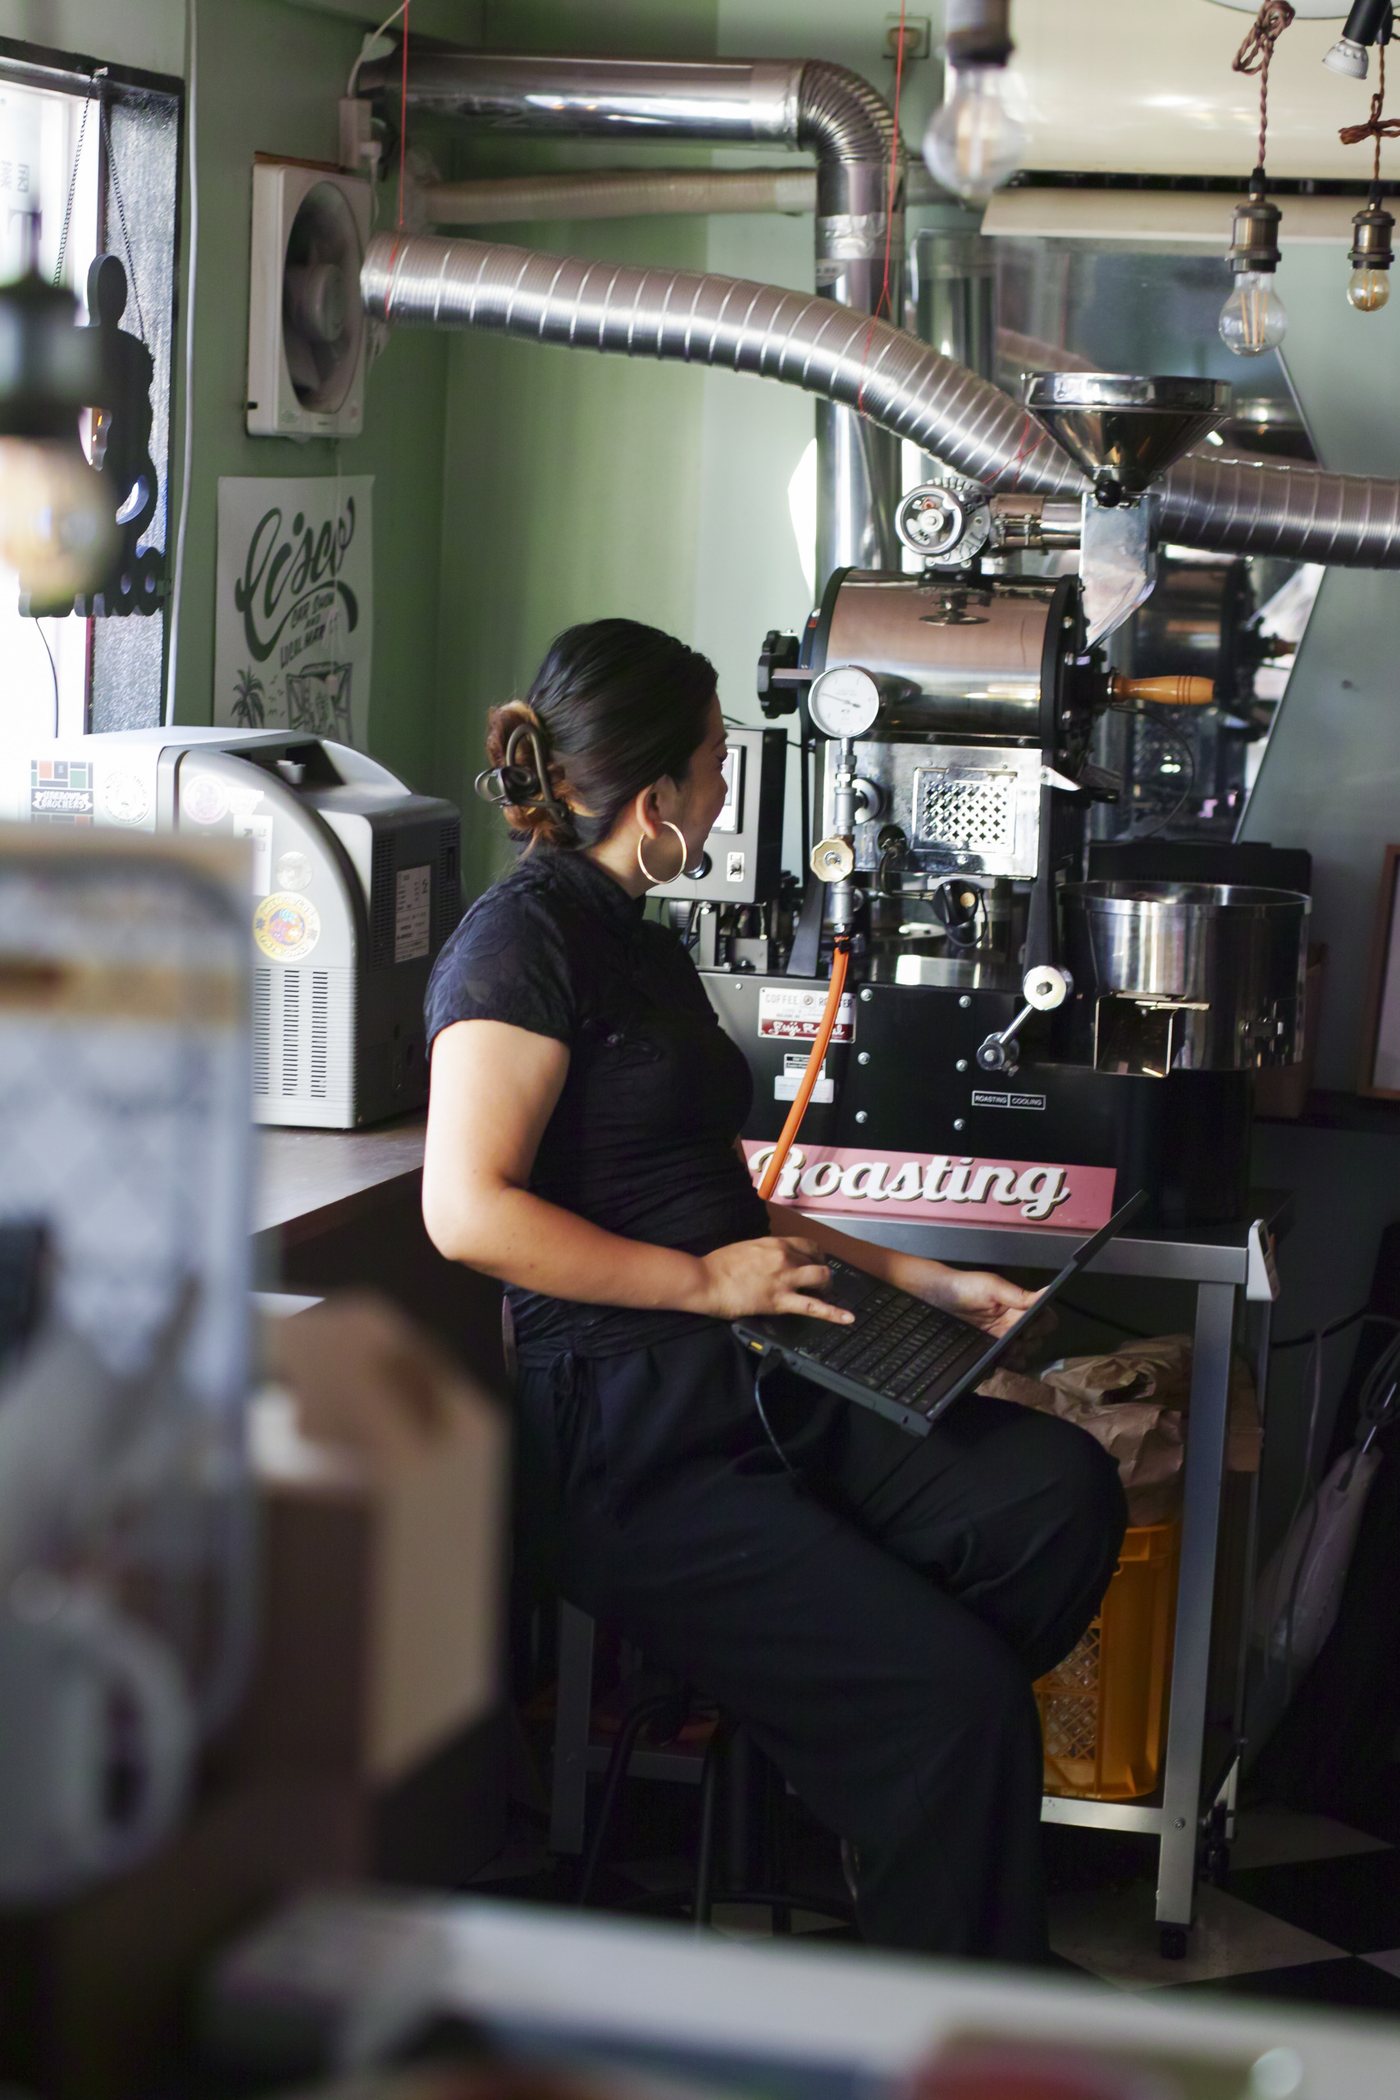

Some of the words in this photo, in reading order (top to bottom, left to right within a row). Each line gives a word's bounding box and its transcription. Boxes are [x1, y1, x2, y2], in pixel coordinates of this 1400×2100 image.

[235, 496, 356, 662] Cisco
[765, 993, 798, 1005] COFFEE
[974, 1095, 1007, 1104] ROASTING
[1012, 1097, 1043, 1106] COOLING
[749, 1145, 1071, 1221] Roasting
